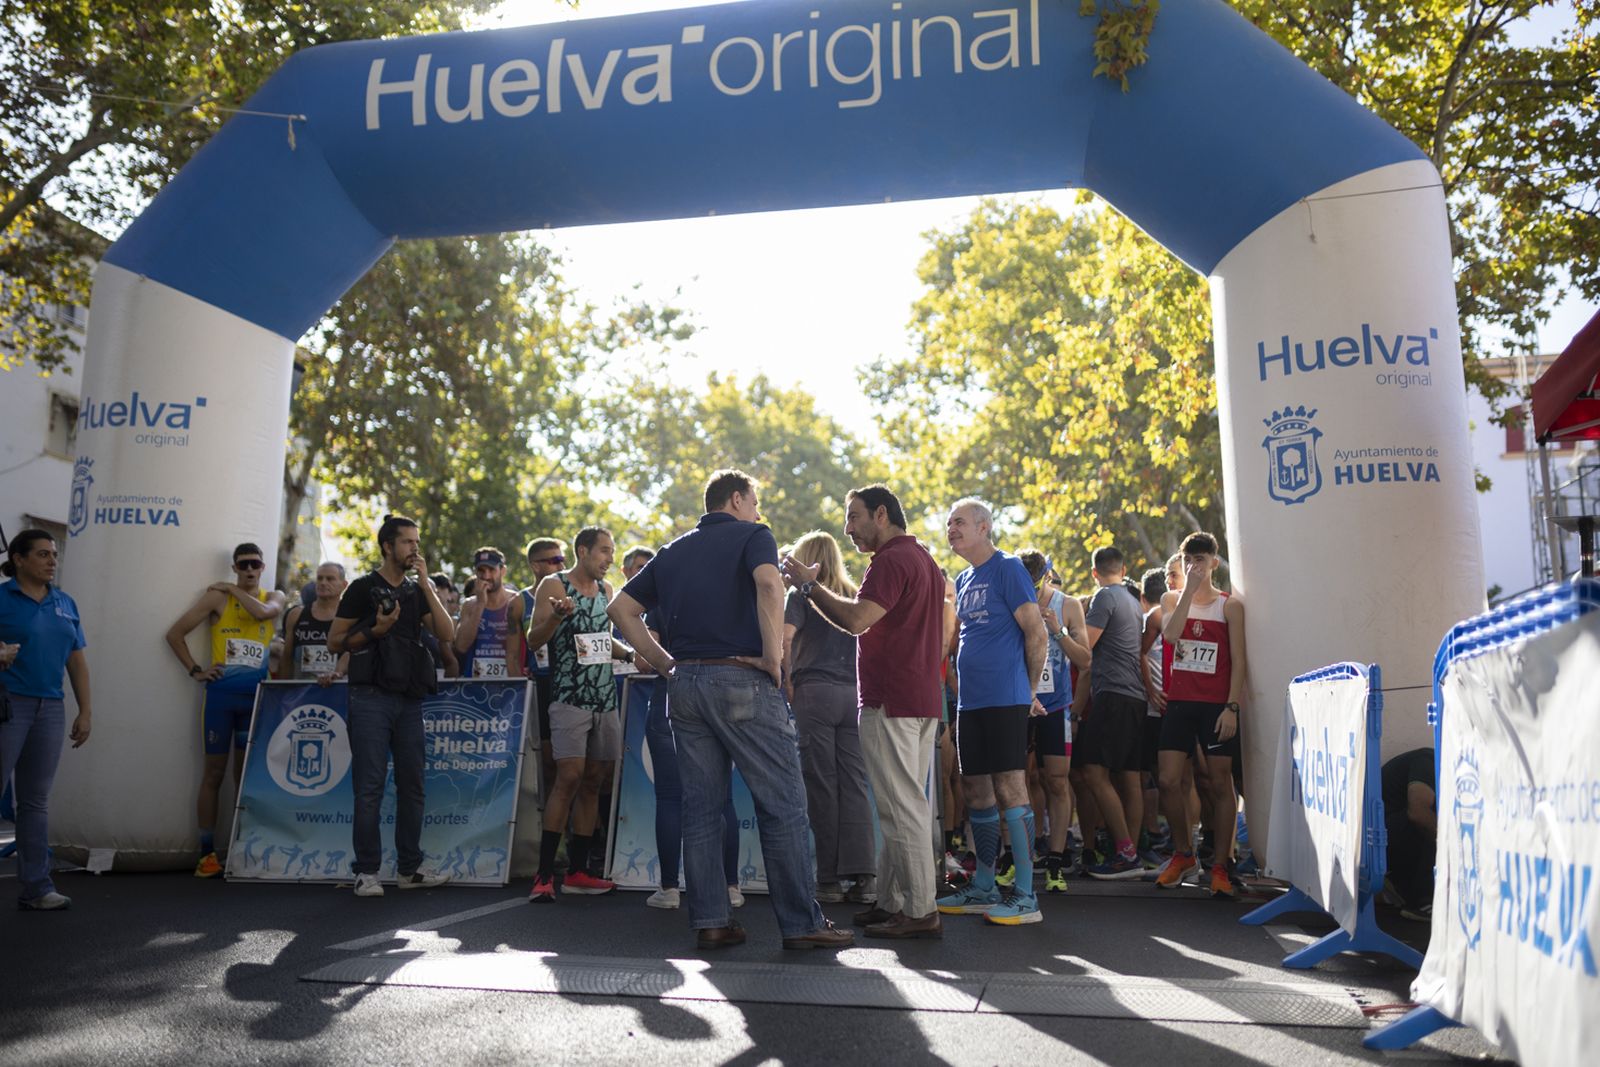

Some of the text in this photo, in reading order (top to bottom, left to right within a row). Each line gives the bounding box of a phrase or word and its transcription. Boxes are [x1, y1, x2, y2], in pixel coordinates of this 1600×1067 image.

[366, 0, 1041, 130] Huelva original
[1257, 323, 1431, 381] Huelva
[1376, 370, 1432, 388] original
[78, 391, 192, 430] Huelva
[135, 431, 189, 448] original
[1334, 445, 1439, 462] Ayuntamiento de
[1334, 462, 1441, 485] HUELVA
[96, 494, 183, 507] Ayuntamiento de
[94, 507, 181, 527] HUELVA
[242, 644, 262, 659] 302
[592, 639, 611, 652] 376
[1192, 646, 1216, 662] 177
[316, 650, 335, 662] 251
[486, 663, 507, 675] 287
[424, 714, 511, 733] amiento
[434, 736, 507, 754] Huelva
[434, 759, 450, 770] de
[452, 759, 508, 772] Deportes
[1291, 725, 1347, 825] Huelva
